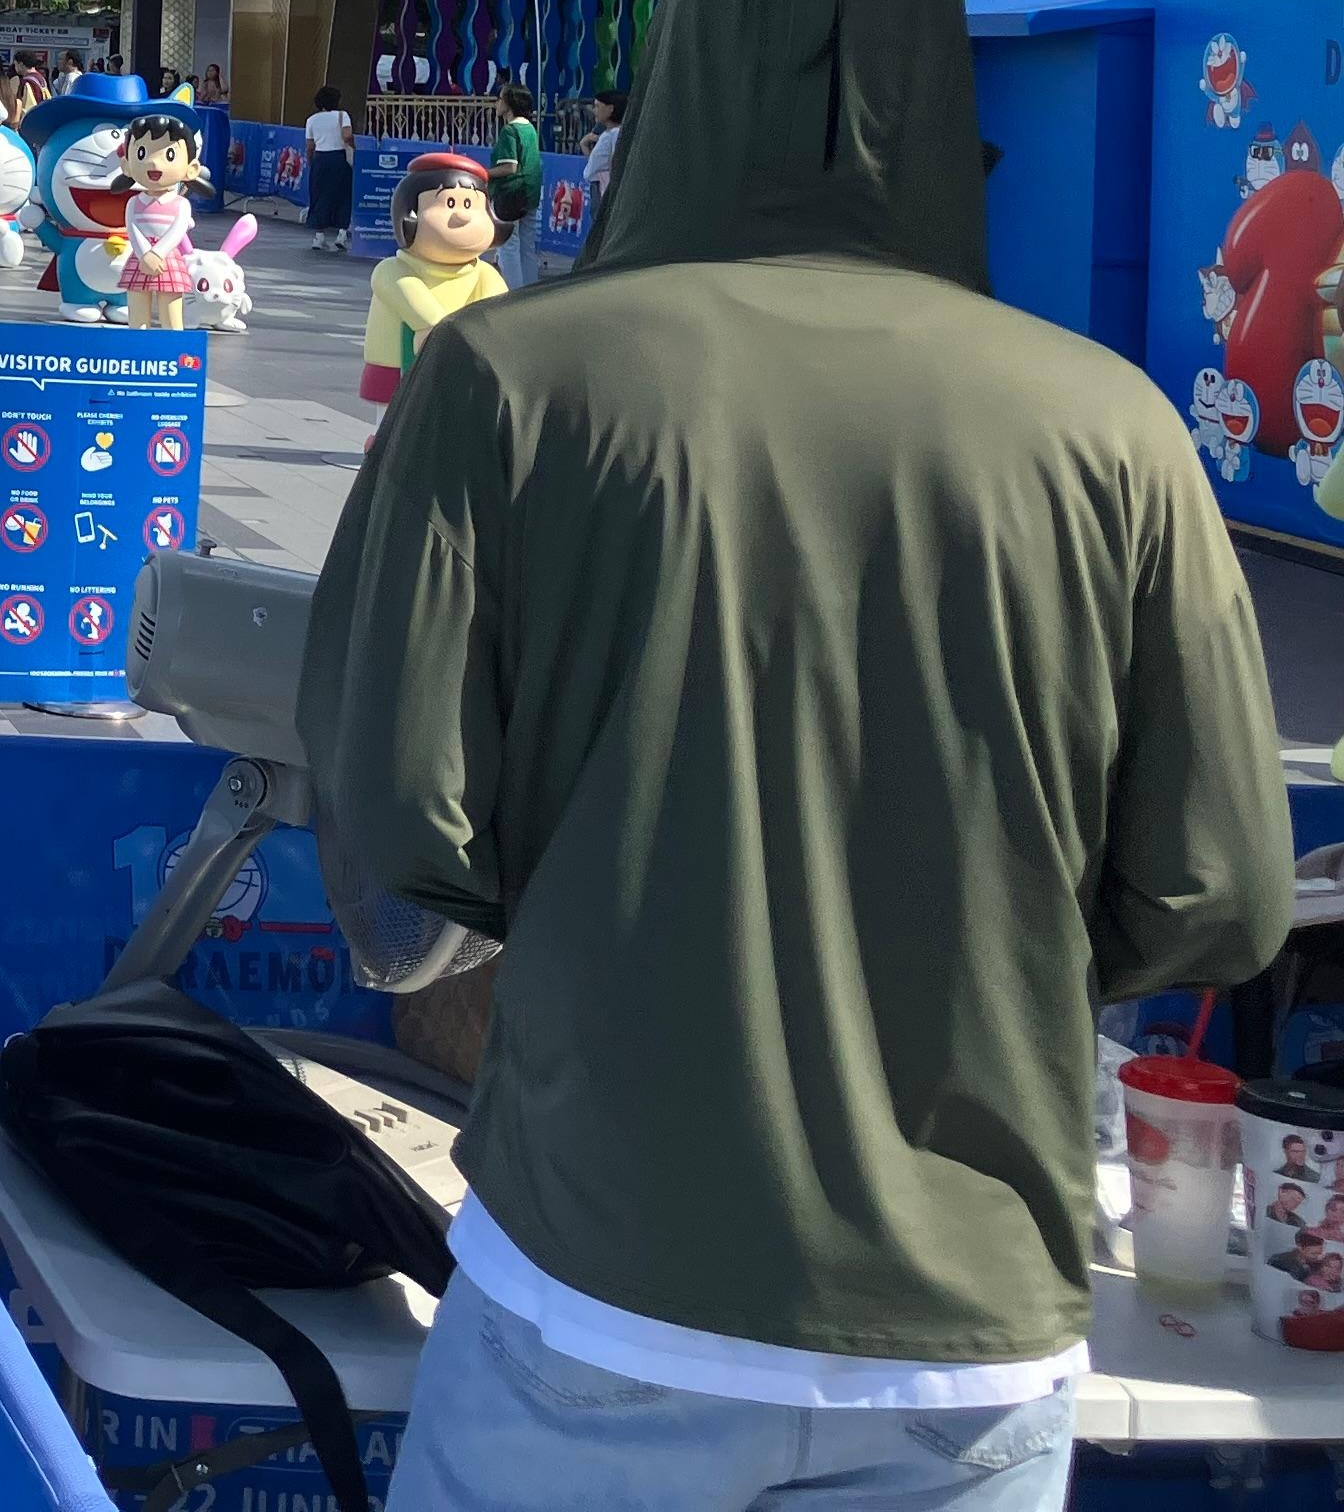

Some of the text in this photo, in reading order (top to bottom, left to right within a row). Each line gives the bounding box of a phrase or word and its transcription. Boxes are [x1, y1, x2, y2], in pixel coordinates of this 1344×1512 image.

[75, 357, 179, 377] GUIDELINES
[1, 411, 52, 421] DON'T TOUCH
[152, 496, 179, 504] NO PETS
[69, 586, 117, 595] NO LITTERING
